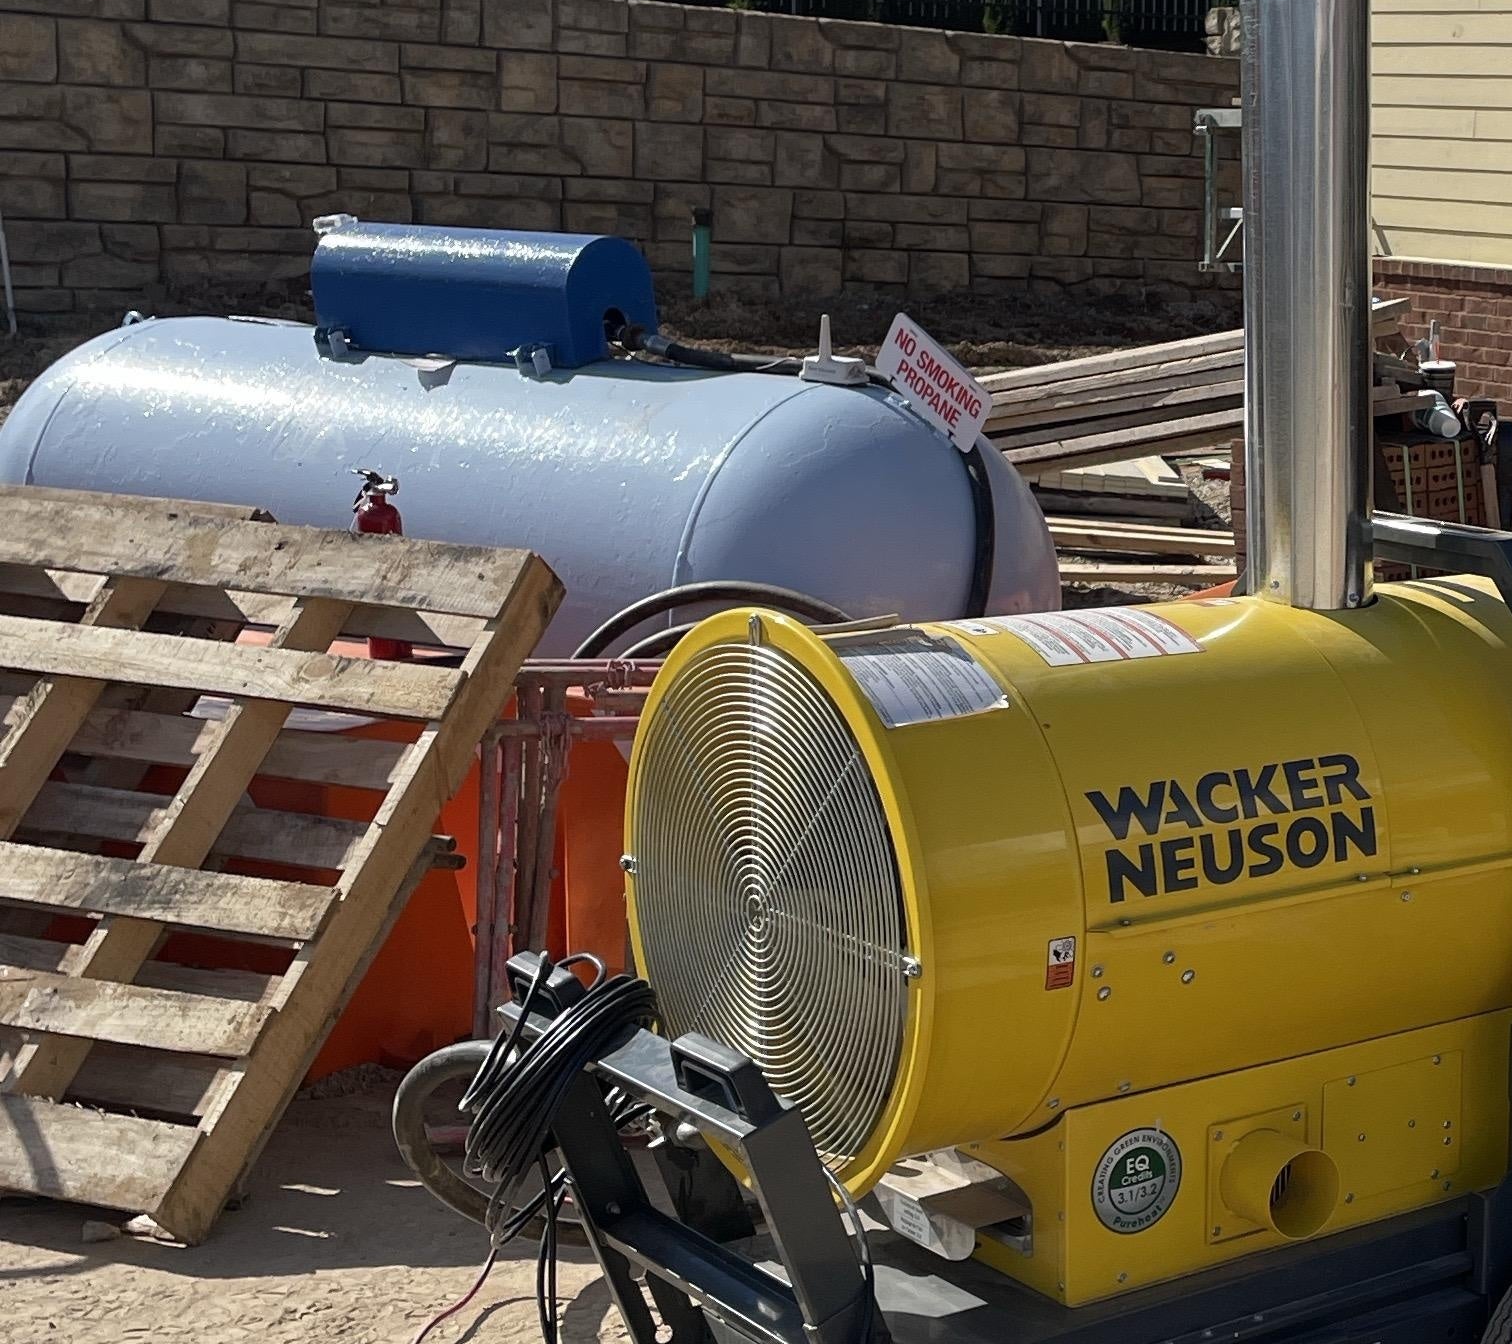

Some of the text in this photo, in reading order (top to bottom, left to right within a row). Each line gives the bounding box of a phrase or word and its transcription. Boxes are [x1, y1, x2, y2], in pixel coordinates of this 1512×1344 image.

[894, 328, 982, 420] NO SMOKING
[896, 359, 962, 429] PROPANE
[1084, 753, 1372, 841] WACKER
[1105, 806, 1378, 904] NEUSON
[1113, 1135, 1140, 1156] GREEN
[1126, 1154, 1151, 1175] EQ
[1121, 1170, 1153, 1186] Credits
[1117, 1182, 1158, 1205] 3.1/3.2
[1112, 1204, 1163, 1229] Pureheat
